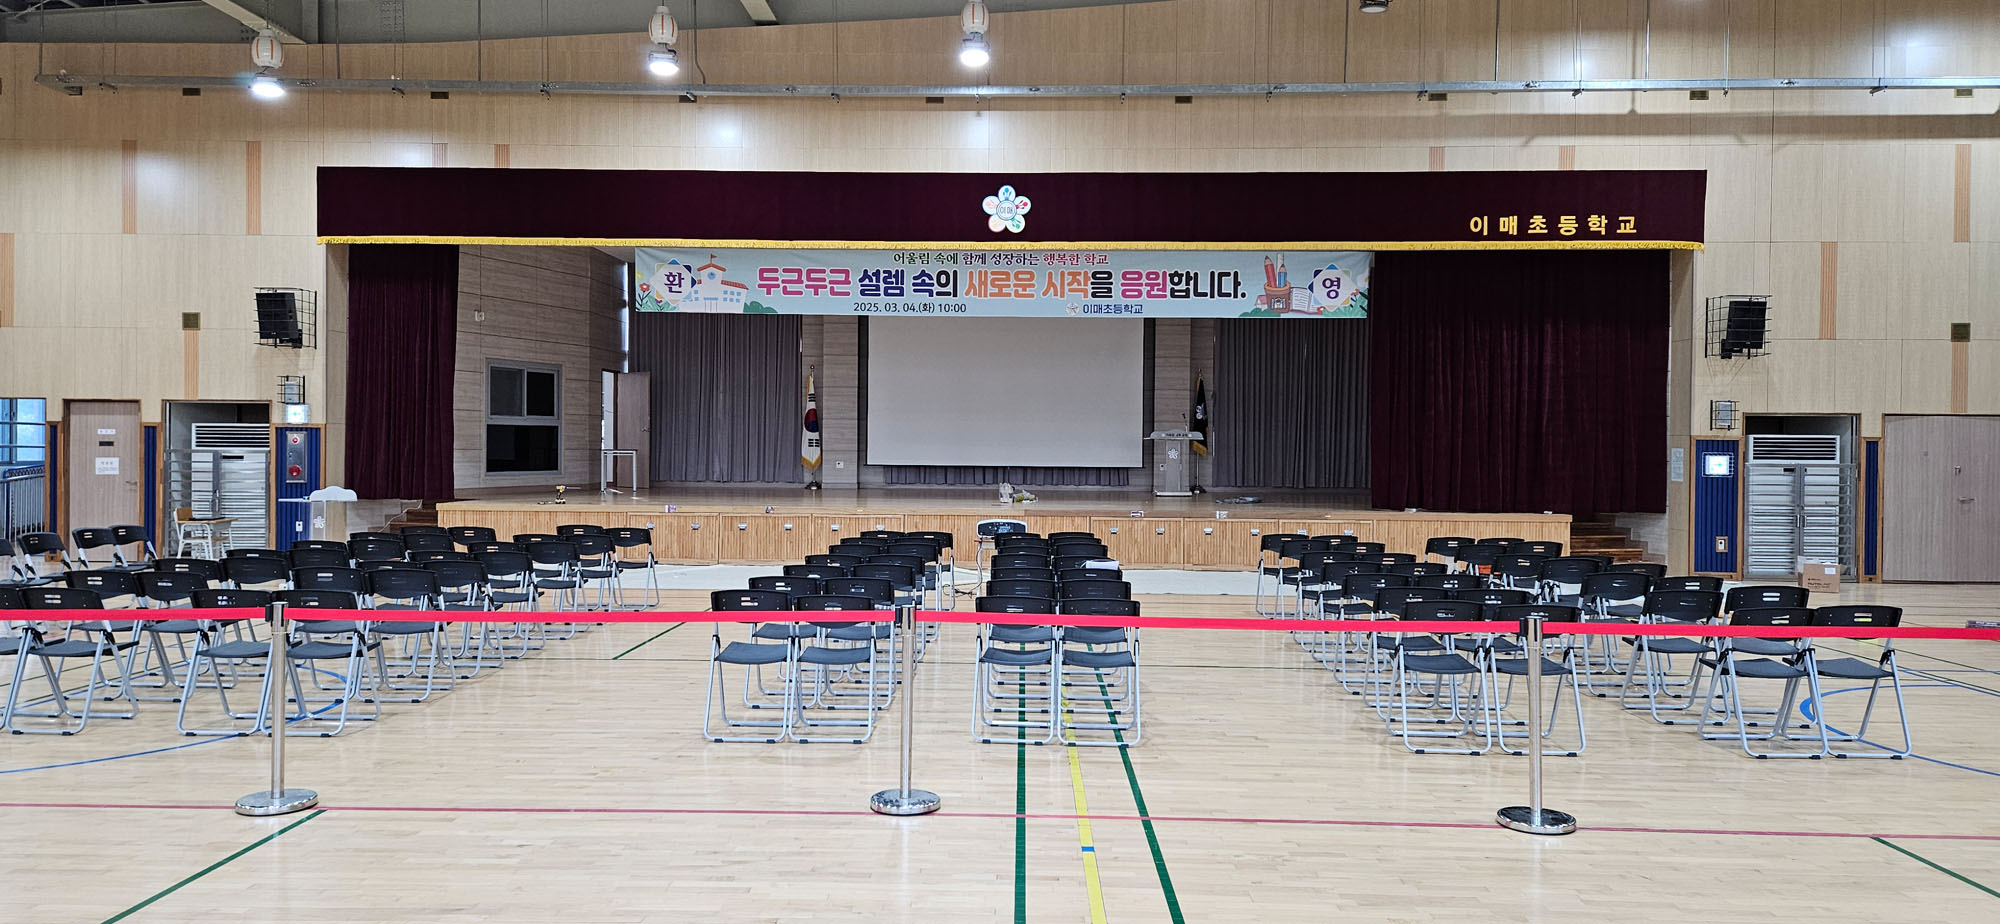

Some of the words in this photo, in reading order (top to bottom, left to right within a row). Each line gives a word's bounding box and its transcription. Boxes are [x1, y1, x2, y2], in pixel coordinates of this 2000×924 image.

[999, 206, 1013, 215] 이매
[1469, 215, 1637, 236] 이매초등학교
[893, 252, 930, 265] 어울림
[934, 252, 958, 265] 속에
[962, 253, 987, 265] 함께
[990, 253, 1039, 266] 성장하는
[1043, 253, 1080, 266] 행복한
[1084, 253, 1109, 266] 학교
[663, 272, 685, 294] 환
[757, 267, 851, 296] 두근두근
[858, 268, 905, 297] 설렘
[912, 269, 958, 297] 속의
[964, 270, 1036, 298] 새로운
[1041, 270, 1114, 299] 시작을
[1120, 270, 1247, 299] 응원합니다.
[1321, 276, 1342, 300] 영
[853, 302, 882, 312] 2025.
[884, 302, 900, 312] 03.
[902, 302, 935, 313] 04.(화)
[938, 303, 967, 313] 10:00
[1082, 303, 1143, 315] 이매초등학교
